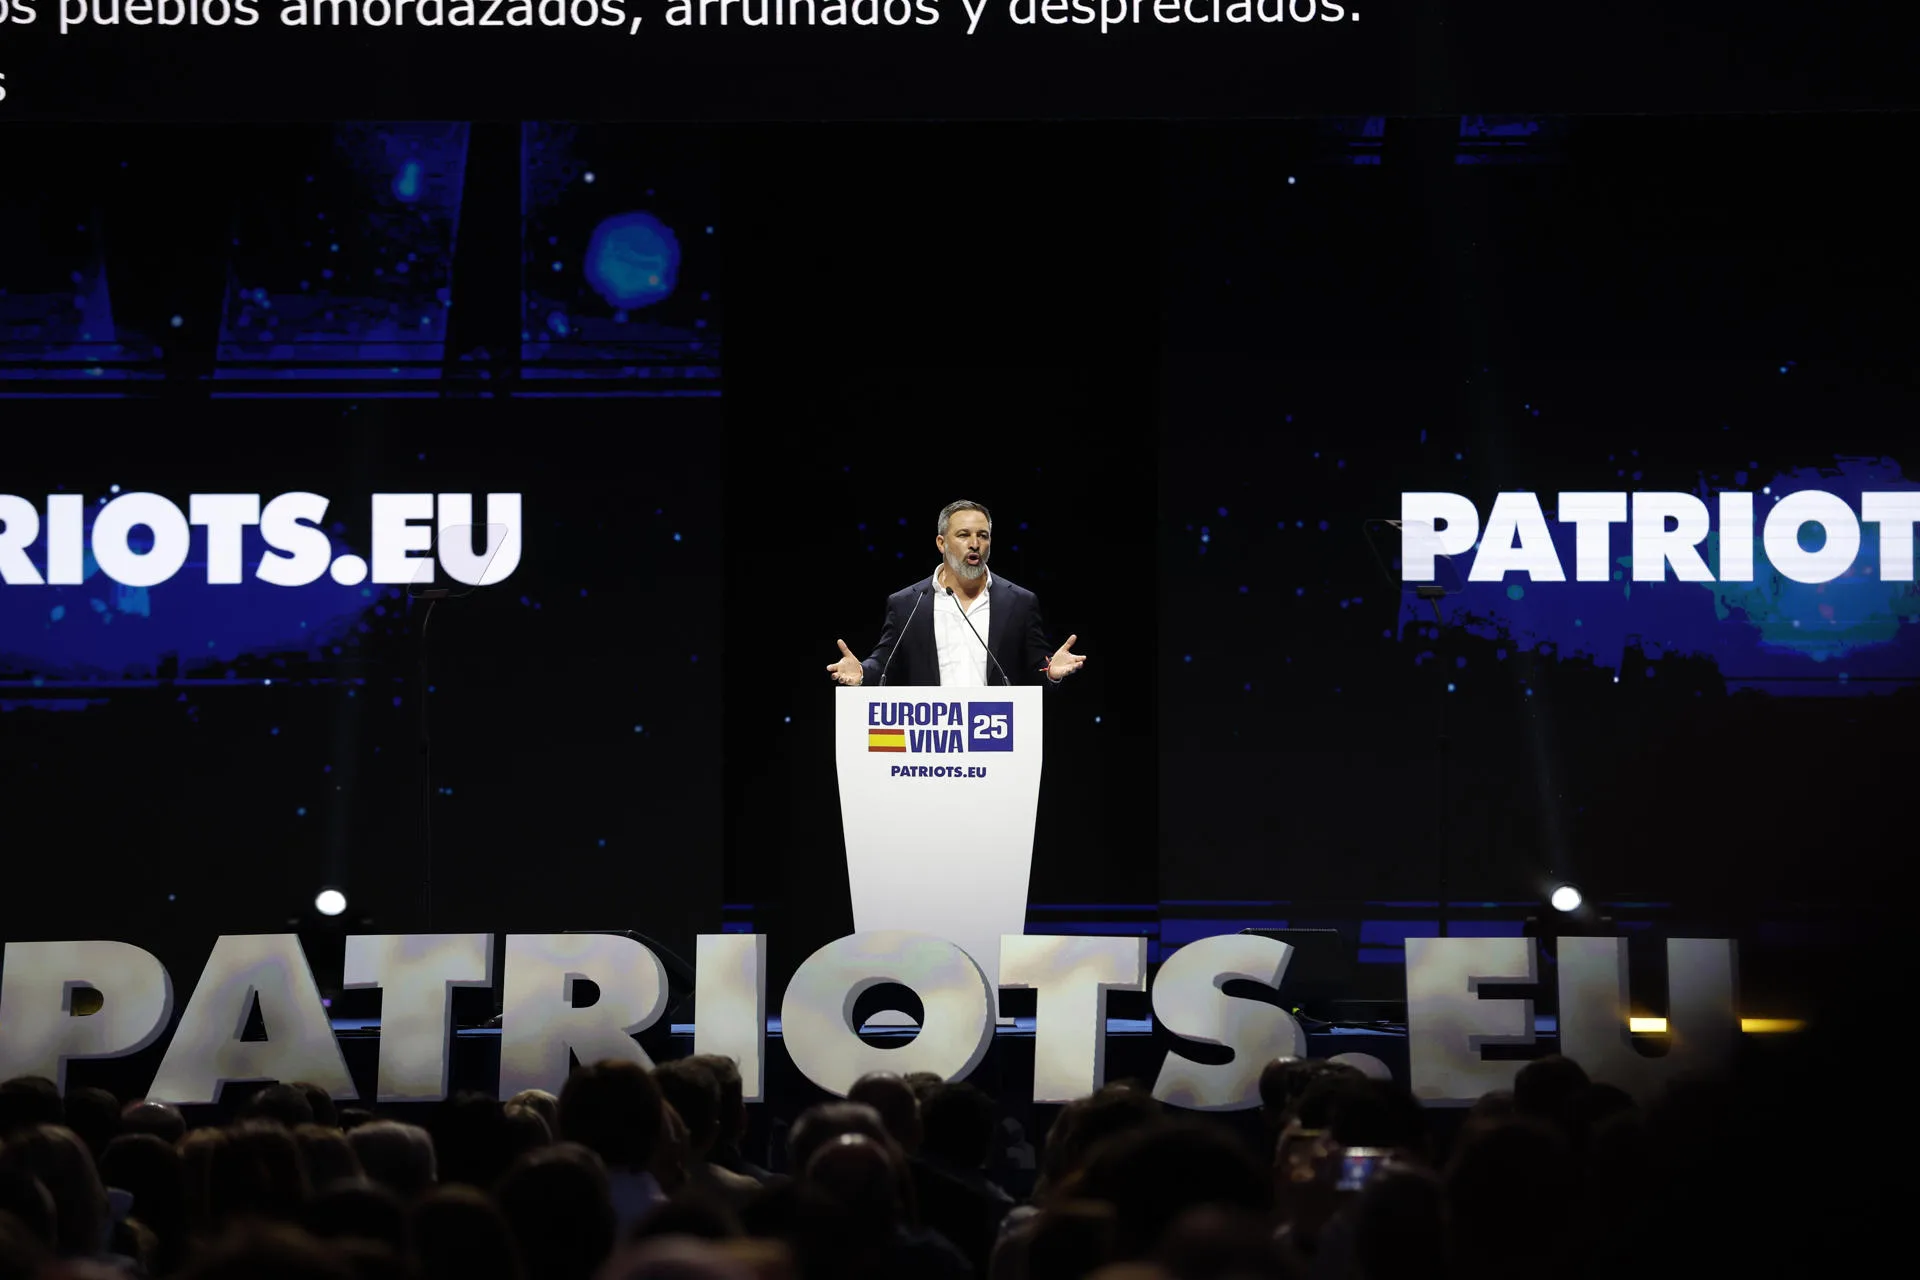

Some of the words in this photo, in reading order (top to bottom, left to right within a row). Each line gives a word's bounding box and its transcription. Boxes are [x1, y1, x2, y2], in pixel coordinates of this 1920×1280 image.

[60, 0, 259, 35] pueblos
[281, 0, 643, 36] amordazados,
[666, 0, 939, 26] arruinados
[962, 0, 988, 34] y
[1009, 0, 1360, 34] despreciados.
[1400, 490, 1920, 584] PATRIOT
[868, 702, 964, 726] EUROPA
[973, 714, 1008, 739] 25
[909, 729, 964, 753] VIVA
[891, 765, 987, 778] PATRIOTS.EU
